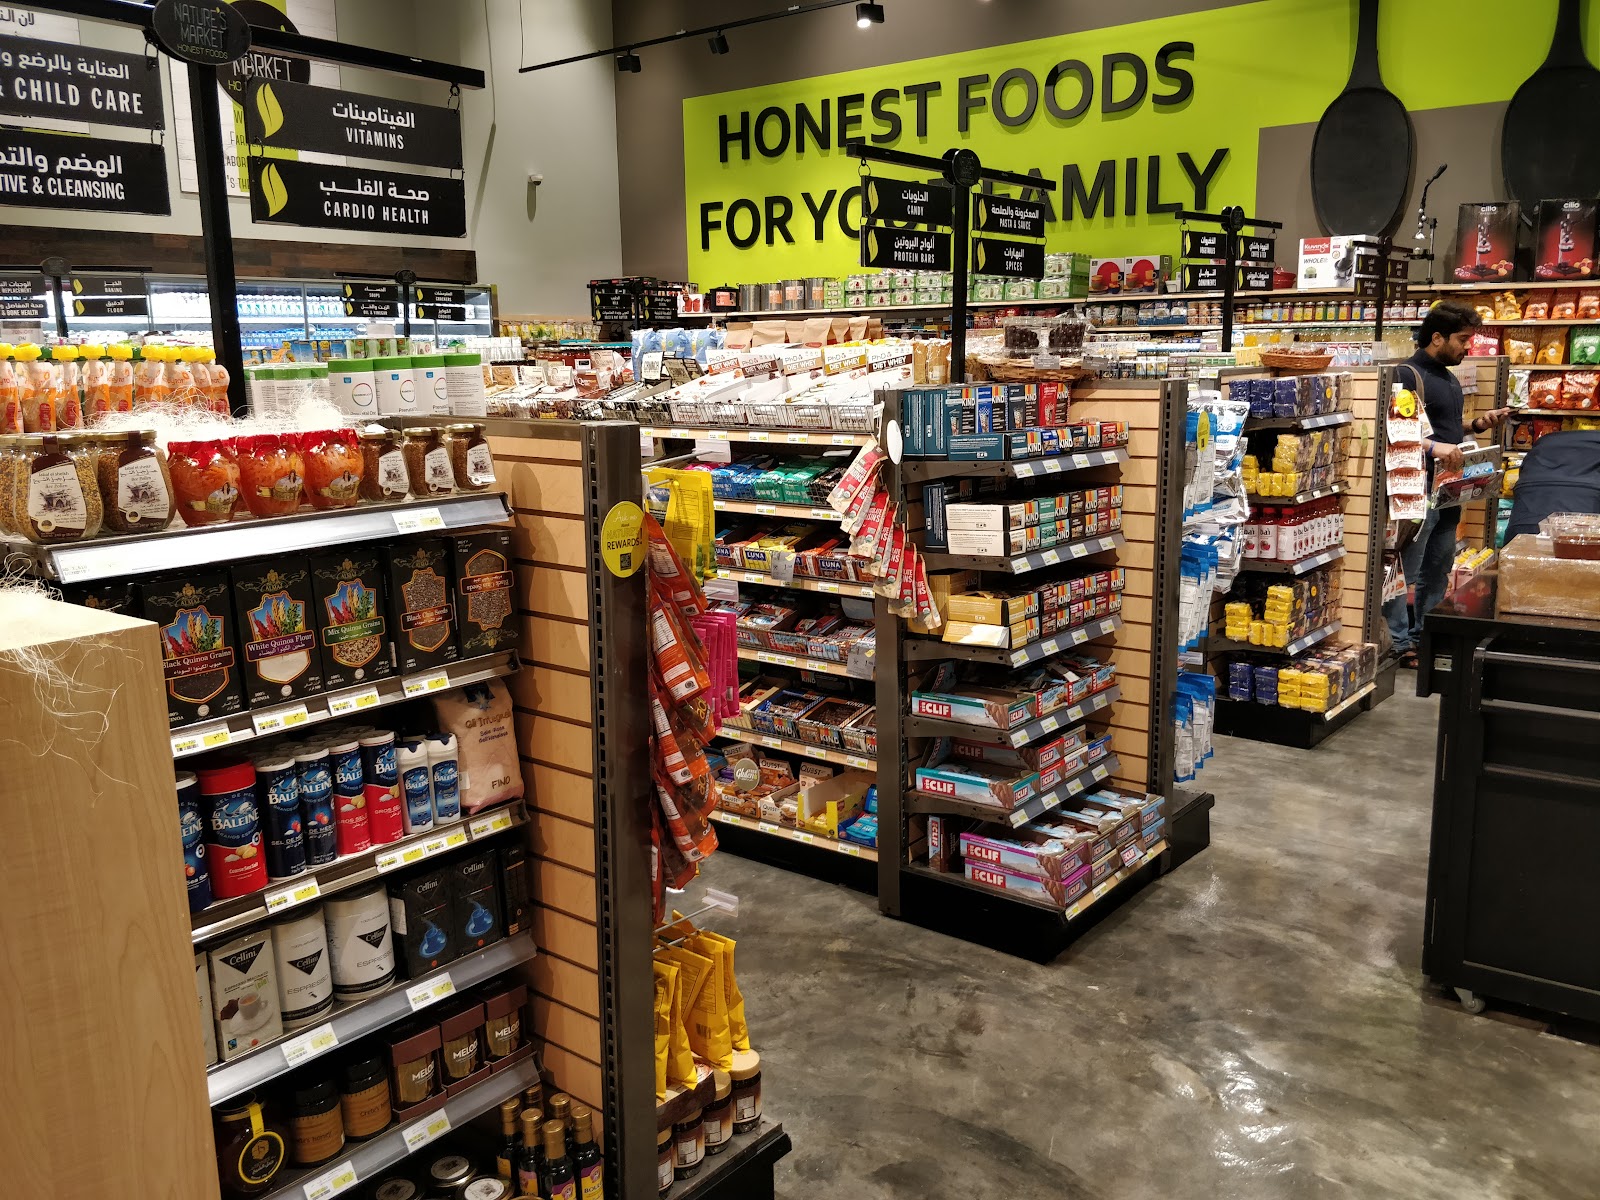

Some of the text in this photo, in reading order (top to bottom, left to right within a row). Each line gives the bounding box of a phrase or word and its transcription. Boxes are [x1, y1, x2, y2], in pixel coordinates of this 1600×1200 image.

[173, 2, 227, 31] NATURE'S
[180, 22, 225, 49] MARKET
[177, 43, 228, 60] HONEST FOODS
[77, 57, 130, 80] العناية
[232, 53, 292, 82] MARKET
[14, 76, 144, 114] CHILD CARE
[718, 40, 1196, 163] HONEST FOODS
[332, 102, 415, 130] الفيتامينات
[345, 126, 404, 150] VITAMINS
[56, 153, 123, 179] الهضم
[32, 177, 43, 195] &
[47, 177, 125, 200] CLEANSING
[388, 181, 430, 201] صحة
[901, 189, 929, 203] الحلويات
[324, 201, 429, 224] CARDIO HEALTH
[907, 205, 924, 217] CANDY
[699, 195, 795, 251] FOR
[894, 251, 935, 264] PROTEIN BARS
[1005, 261, 1023, 271] SPICES
[711, 360, 738, 371] DIET WHEY
[745, 363, 773, 373] DIET WHEY
[787, 360, 816, 371] DIET WHEY
[829, 357, 860, 370] DIET WHEY
[872, 356, 907, 370] DIET WHEY
[1025, 393, 1037, 401] KIND
[1057, 391, 1069, 399] KIND
[962, 398, 975, 406] KIND
[1059, 440, 1073, 448] KIND
[1088, 436, 1100, 444] KIND
[1028, 444, 1041, 452] KIND
[1111, 495, 1123, 504] KIND
[1055, 507, 1068, 516] KIND
[1085, 502, 1098, 510] KIND
[1026, 513, 1039, 521] KIND
[1110, 518, 1121, 527] KIND
[1057, 531, 1070, 540] KIND
[1086, 525, 1098, 534] KIND
[1027, 538, 1040, 547] KIND
[747, 551, 765, 560] LUNA
[821, 560, 841, 569] LUNA
[1111, 579, 1125, 588] KIND
[1084, 587, 1097, 596] KIND
[1058, 594, 1071, 604] KIND
[1025, 605, 1039, 614] KIND
[1109, 601, 1121, 610] KIND
[406, 614, 421, 622] Black
[1084, 610, 1095, 618] KIND
[327, 626, 340, 636] Mix
[341, 623, 362, 634] Quinoa
[363, 619, 381, 629] Grains
[1057, 618, 1070, 628] KIND
[1027, 629, 1040, 639] KIND
[248, 633, 312, 653] White Quinoa Flour
[182, 654, 208, 666] Quinoa
[209, 649, 232, 660] Grains
[925, 703, 950, 716] CLIF
[1013, 710, 1024, 721] CLIF
[775, 725, 793, 735] KIND
[820, 735, 839, 745] KIND
[1065, 738, 1074, 746] CLIF
[959, 746, 981, 757] CLIF
[1044, 751, 1054, 760] CLIF
[1092, 747, 1101, 756] CLIF
[761, 760, 780, 768] QUEST
[801, 764, 822, 776] QUEST
[1067, 760, 1077, 769] CLIF
[736, 768, 755, 780] Gluten
[1044, 775, 1054, 785] CLIF
[491, 776, 511, 789] FINO
[930, 780, 954, 793] CLIF
[1018, 788, 1028, 798] CLIF
[211, 807, 259, 831] BALEINE
[1120, 827, 1129, 838] CLIF
[975, 846, 1000, 862] CLIF
[1097, 843, 1105, 855] CLIF
[1126, 849, 1137, 861] CLIF
[463, 861, 485, 875] Cellini
[1065, 858, 1076, 870] CLIF
[1097, 864, 1105, 876] CLIF
[980, 870, 1005, 886] CLIF
[416, 879, 439, 894] Cellini
[1071, 883, 1081, 896] CLIF
[365, 929, 386, 944] Cellini
[229, 948, 258, 966] Cellini
[296, 955, 319, 968] Cellini
[356, 947, 393, 968] ESPRESSO
[287, 973, 329, 995] ESPRESSO
[312, 1131, 332, 1143] honey
